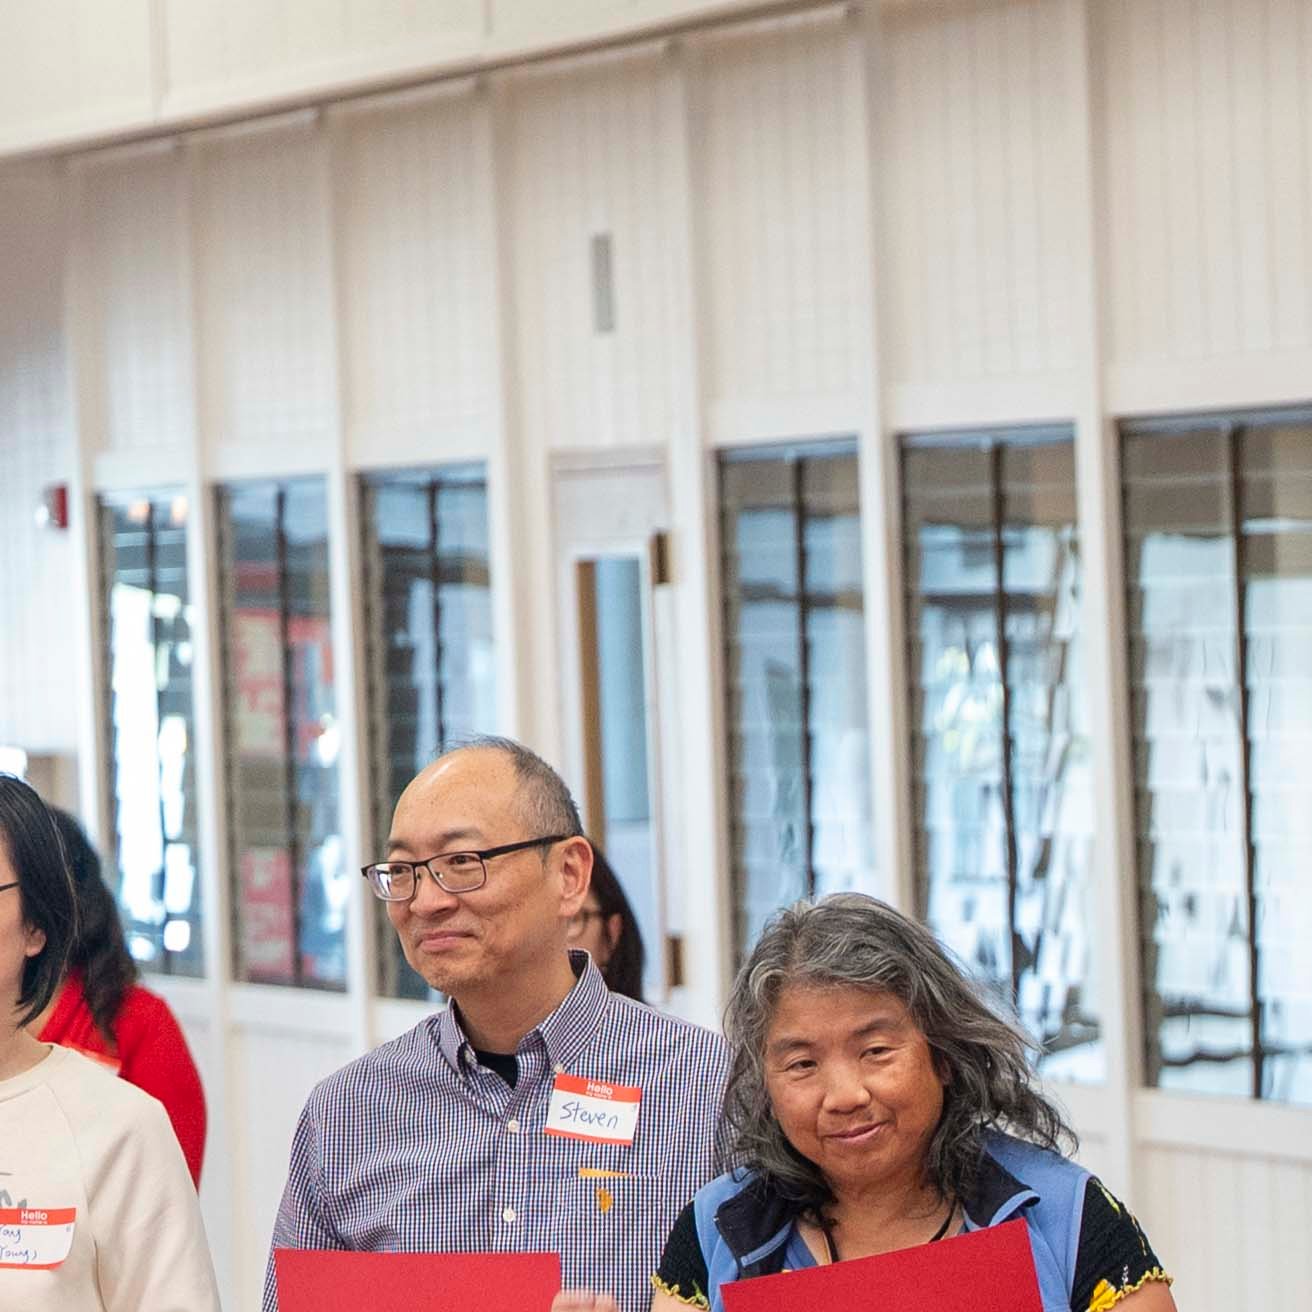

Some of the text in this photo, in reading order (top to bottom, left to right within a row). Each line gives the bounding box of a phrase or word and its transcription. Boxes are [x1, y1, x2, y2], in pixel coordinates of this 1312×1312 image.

[586, 1081, 613, 1096] Hello
[559, 1100, 618, 1130] Steven
[21, 1210, 48, 1221] Hello
